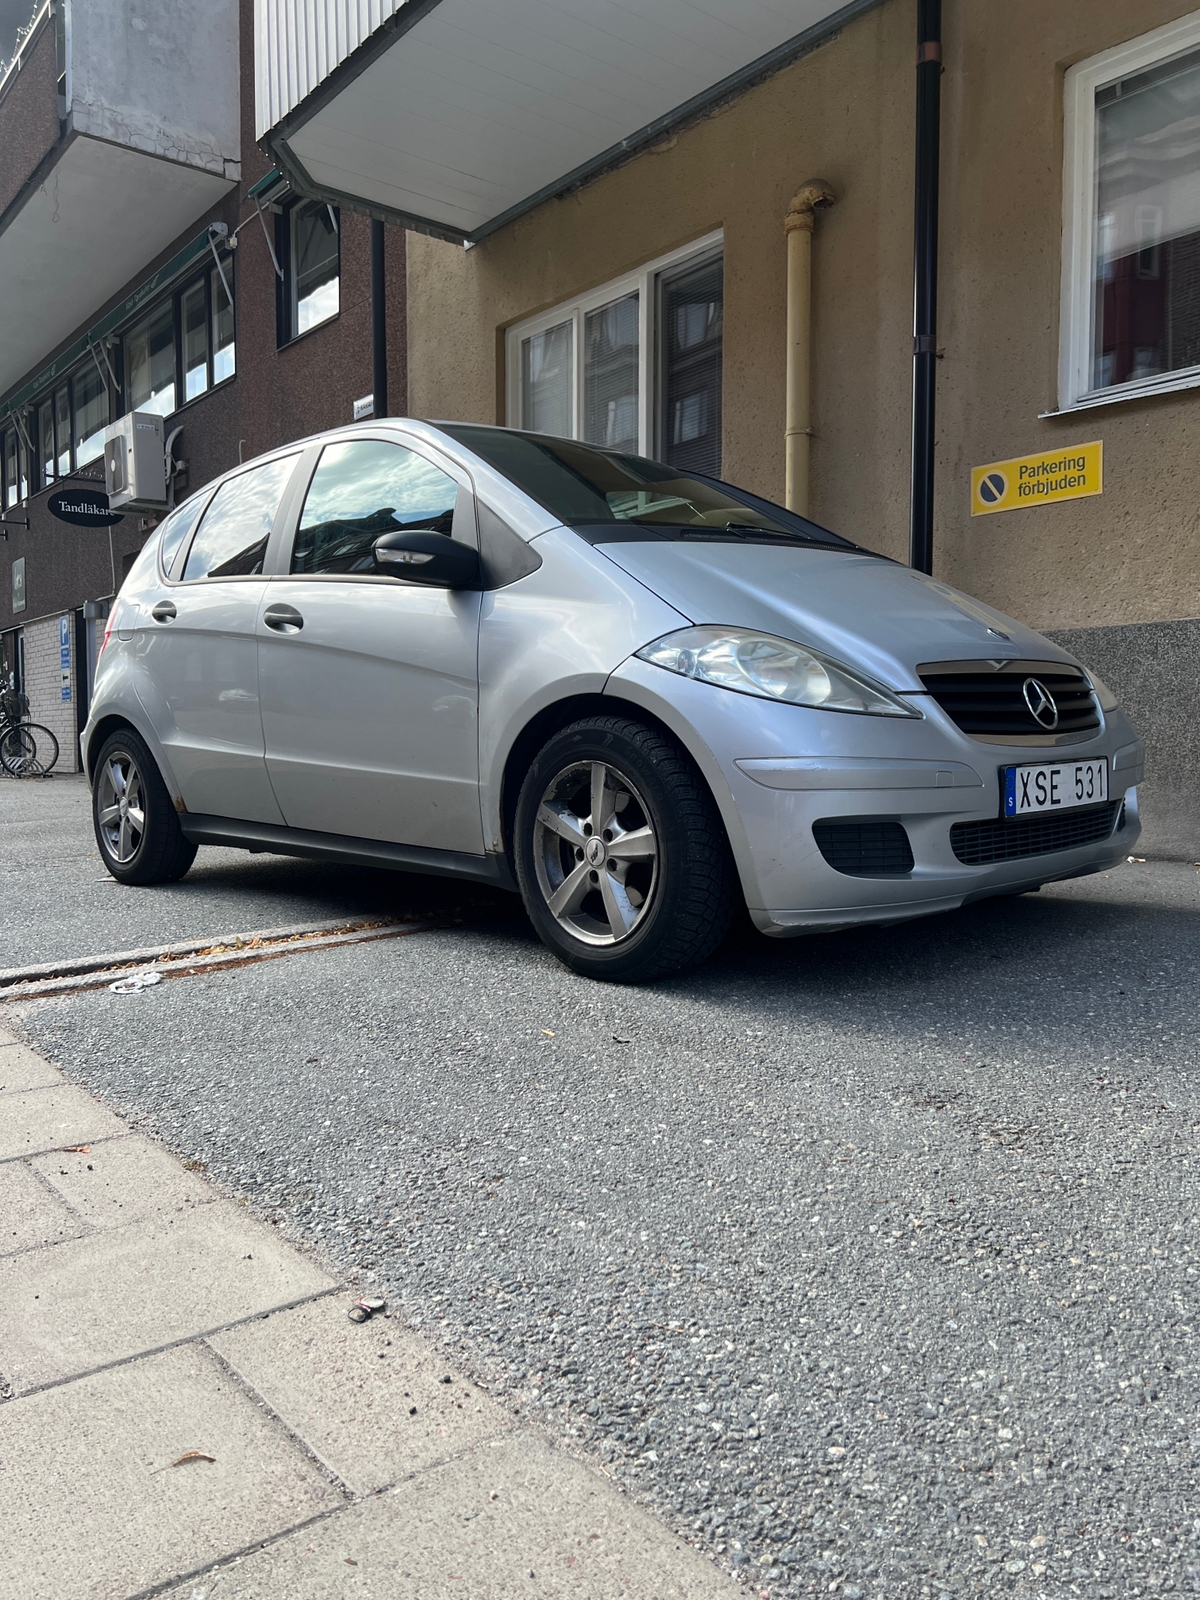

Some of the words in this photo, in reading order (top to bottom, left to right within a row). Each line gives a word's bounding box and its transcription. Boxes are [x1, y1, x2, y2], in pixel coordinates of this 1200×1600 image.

[1019, 456, 1086, 480] Parkering
[1018, 474, 1086, 497] förbjuden
[61, 619, 68, 644] P
[1020, 769, 1061, 808] XSE
[1075, 764, 1102, 800] 531
[1008, 797, 1014, 807] S
